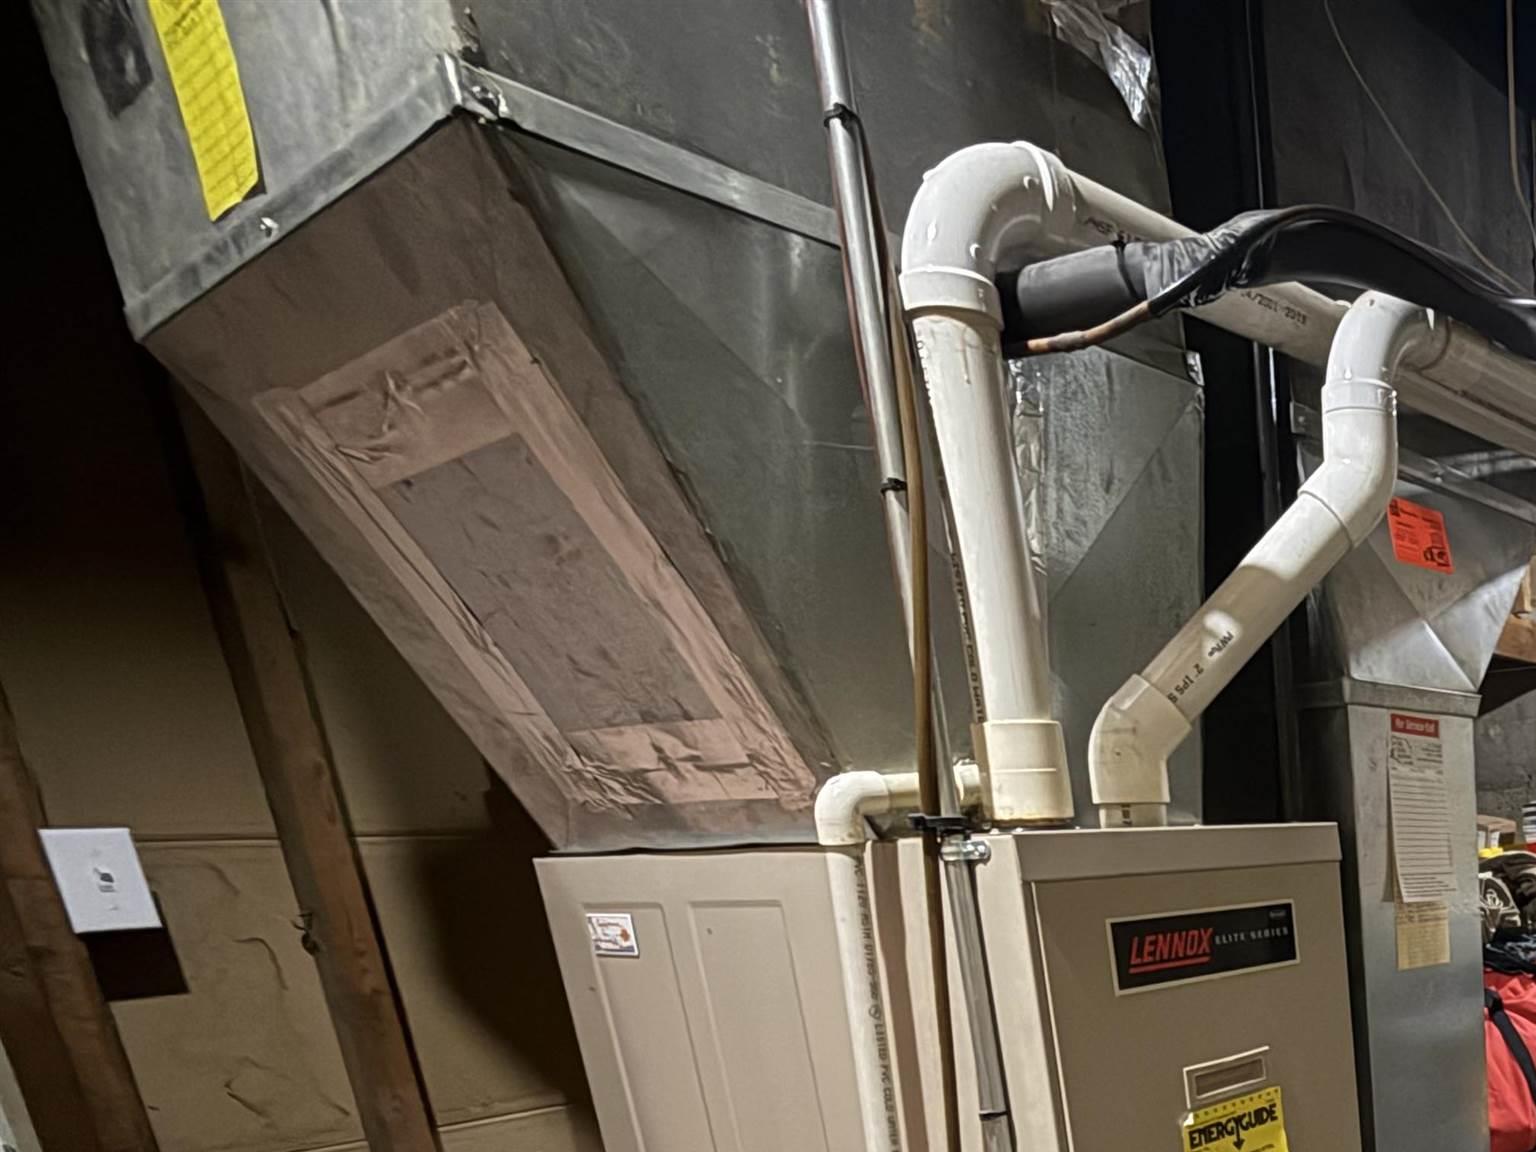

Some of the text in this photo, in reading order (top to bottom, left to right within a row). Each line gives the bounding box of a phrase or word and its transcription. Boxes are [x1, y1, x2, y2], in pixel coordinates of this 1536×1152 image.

[1130, 927, 1288, 966] LENNOX ELITE SERIES
